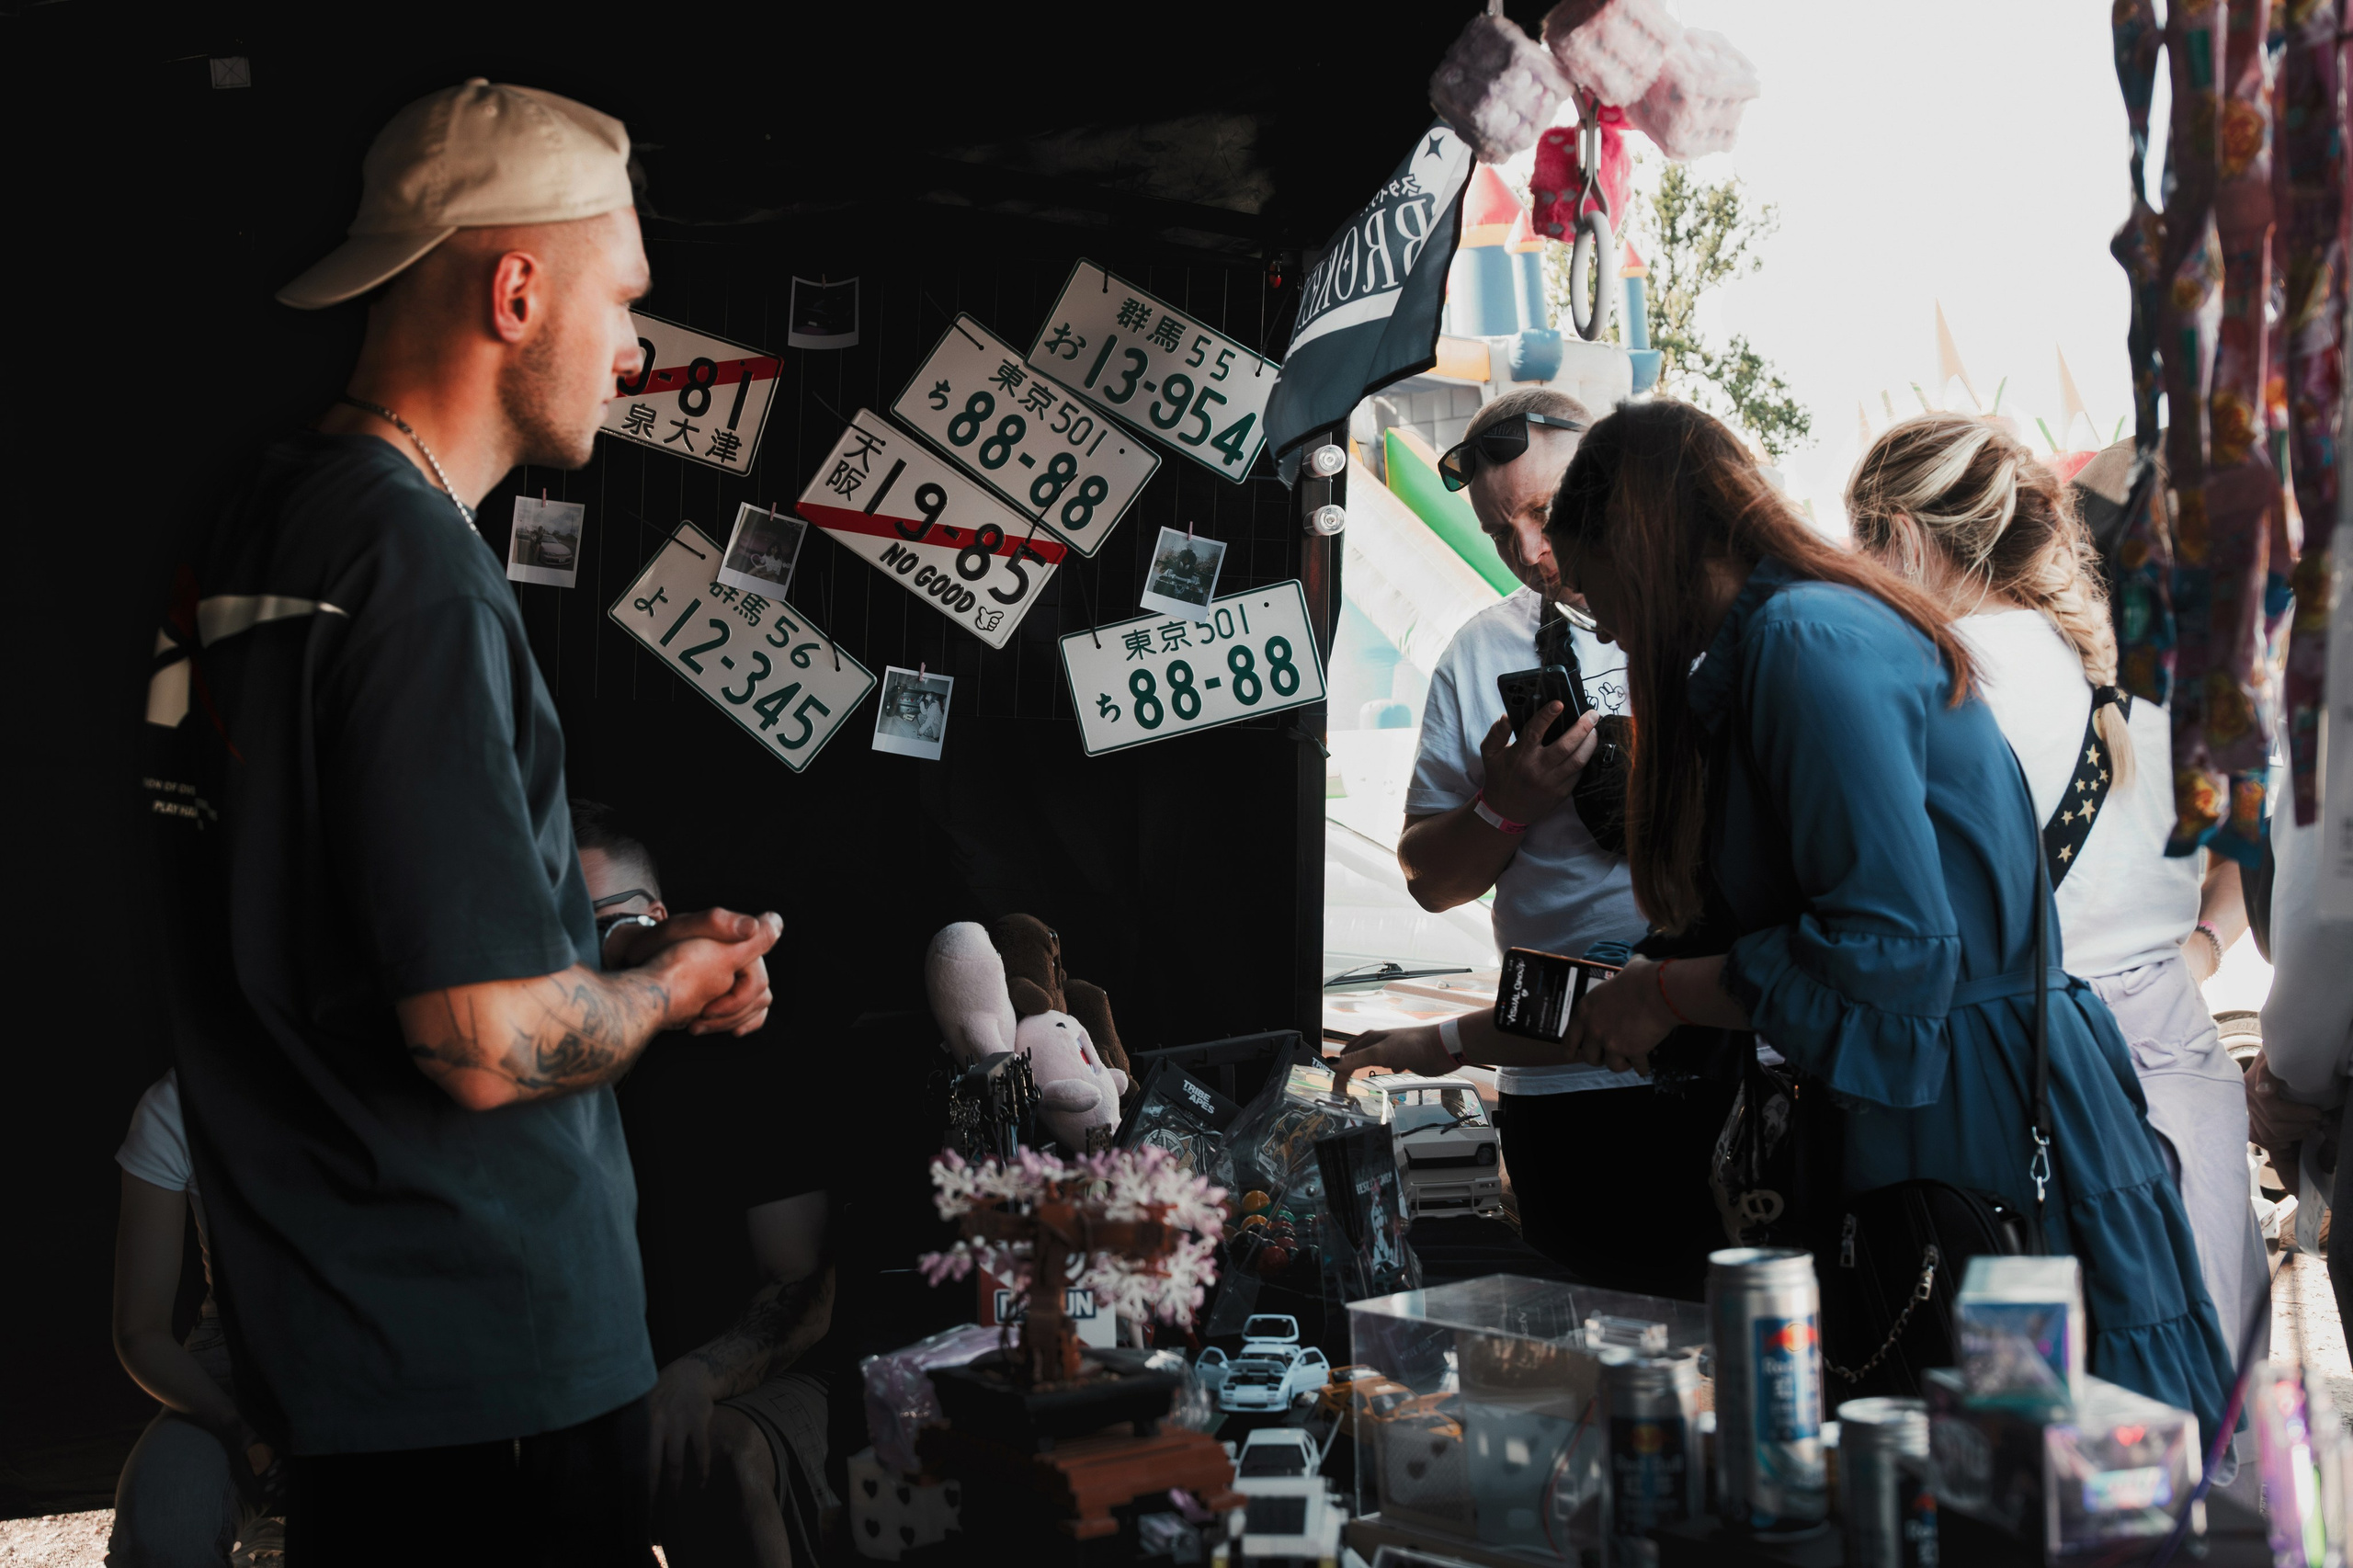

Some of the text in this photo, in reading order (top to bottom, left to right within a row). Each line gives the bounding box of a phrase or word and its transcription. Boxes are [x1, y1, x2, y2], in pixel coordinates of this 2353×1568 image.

[620, 403, 743, 464] 泉大津
[1044, 322, 1257, 467] お 13-954
[825, 435, 882, 502] 大阪
[928, 379, 1109, 531] ち 88-88
[863, 458, 1049, 605] 19-85
[879, 541, 977, 614] NO GOOD
[633, 585, 833, 751] よ 12-345
[1096, 635, 1301, 730] ち 88-88
[1183, 1079, 1211, 1103] TRIBE
[1188, 1093, 1215, 1114] APES
